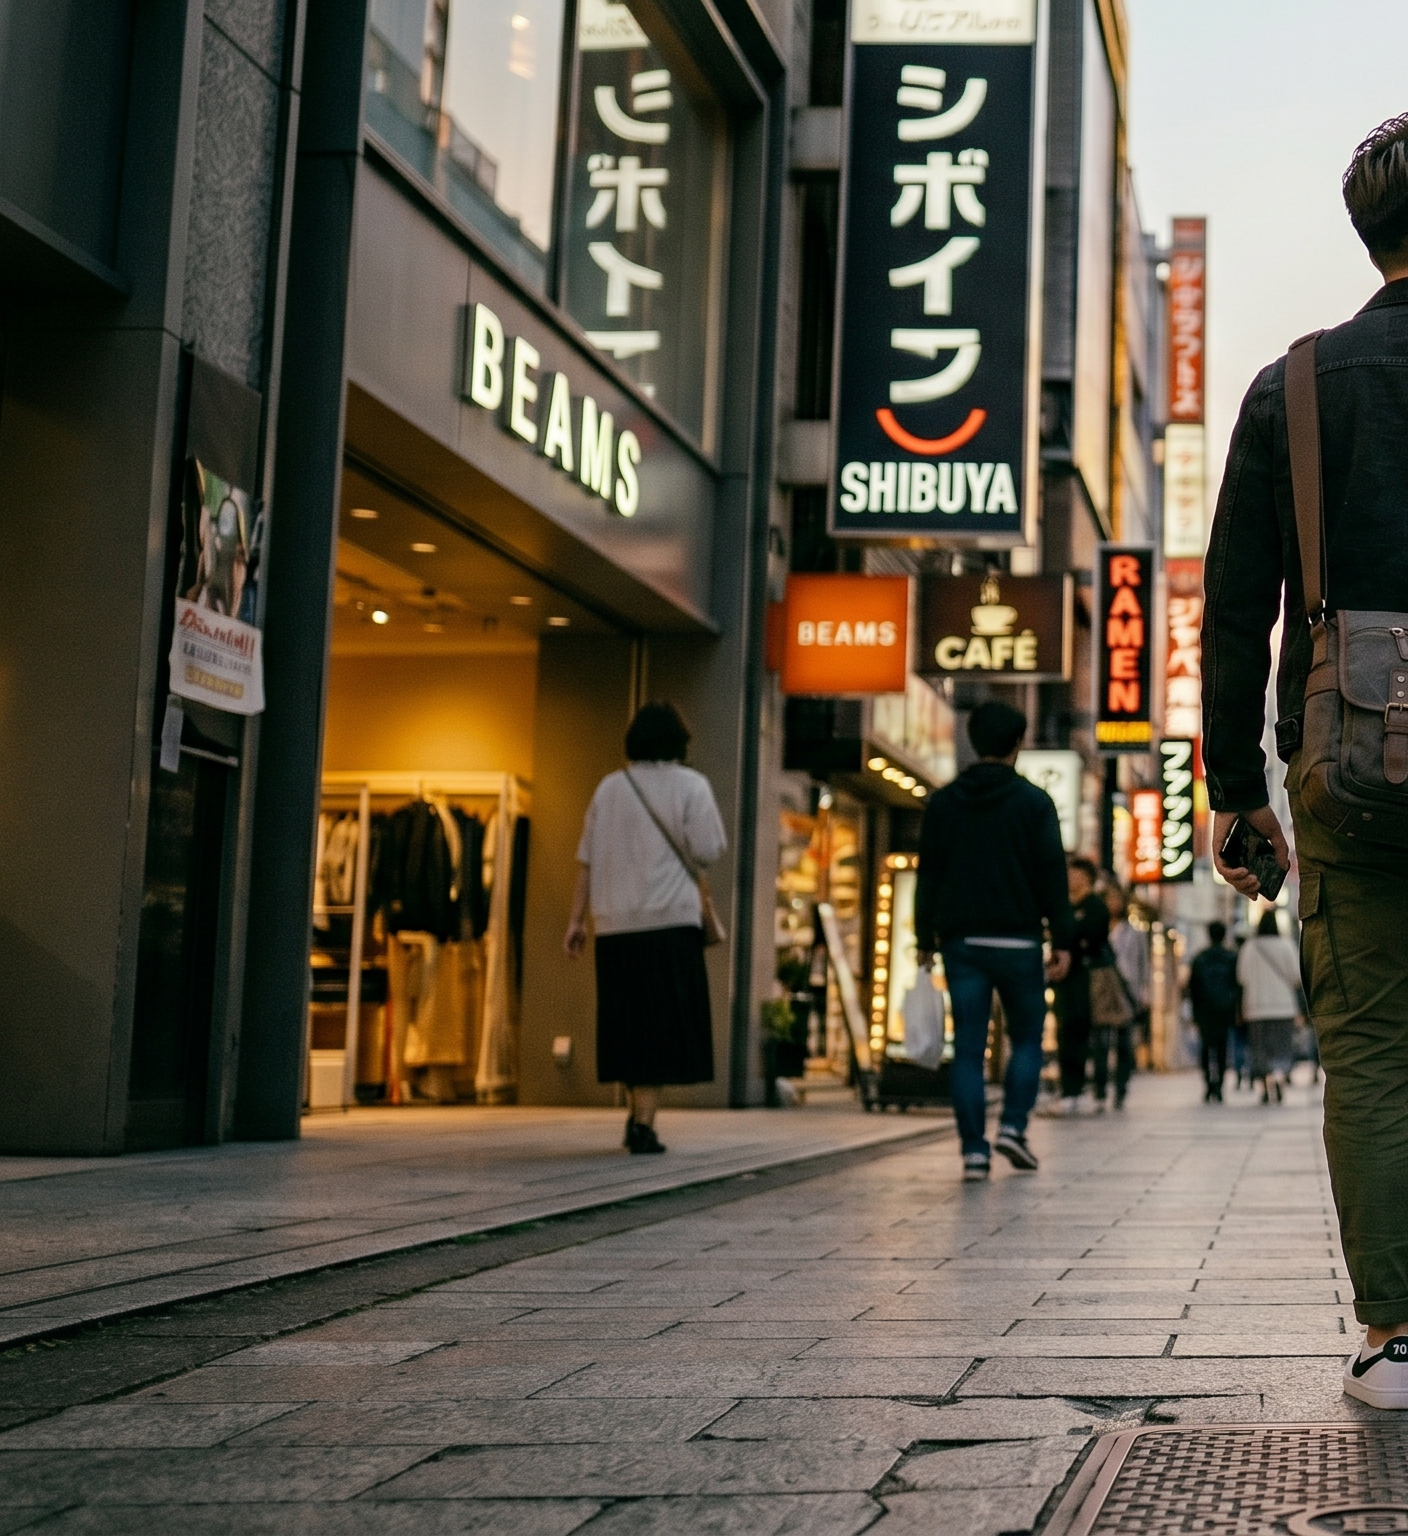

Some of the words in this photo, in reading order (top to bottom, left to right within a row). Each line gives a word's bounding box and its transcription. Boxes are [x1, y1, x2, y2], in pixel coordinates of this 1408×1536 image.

[471, 302, 642, 518] BEAMS
[840, 461, 1018, 515] SHIBUYA
[797, 619, 898, 648] BEAMS
[934, 628, 1038, 671] CAFÉ
[1106, 554, 1146, 714] RAMEN
